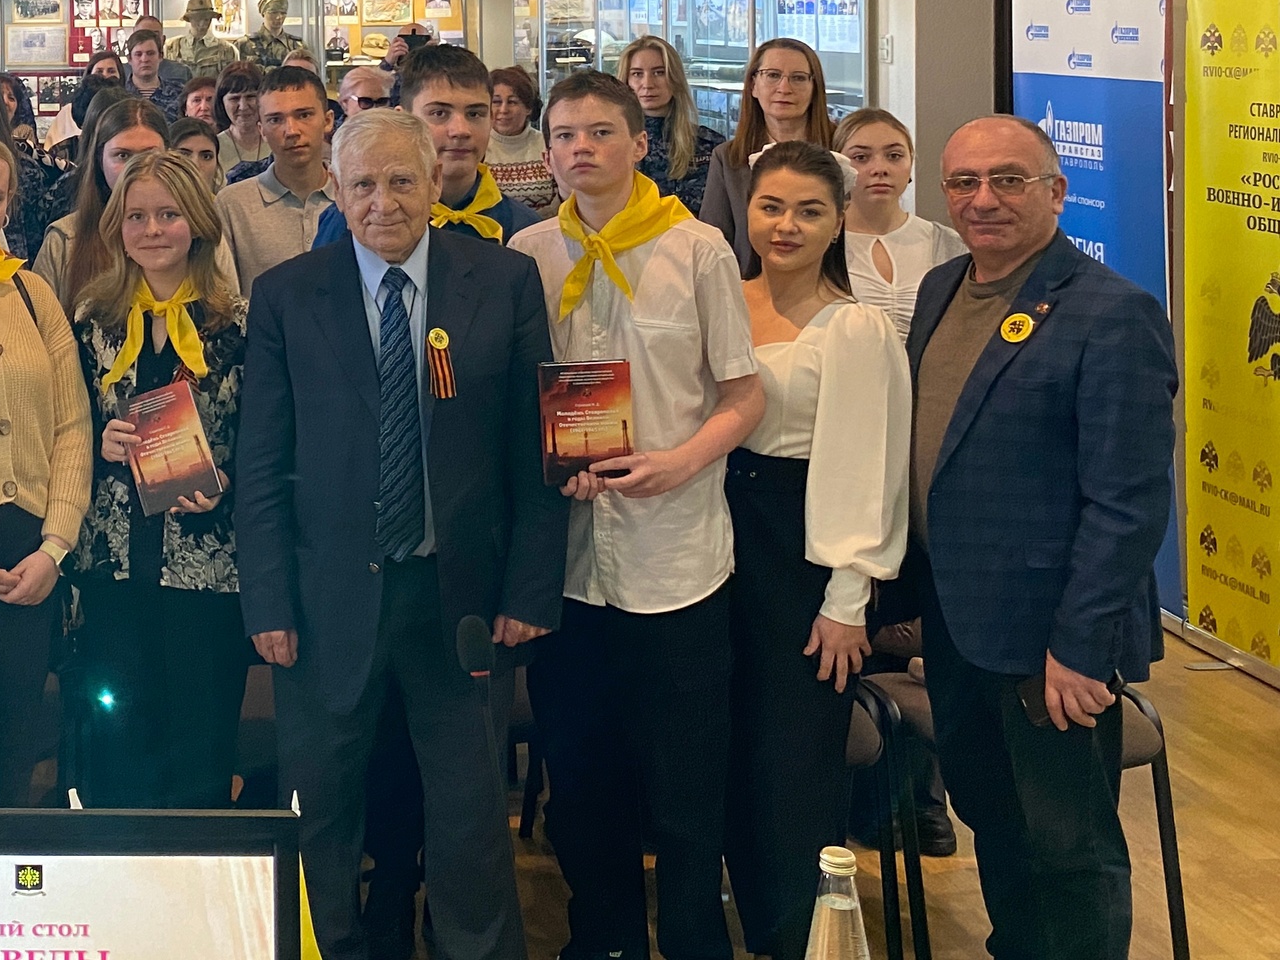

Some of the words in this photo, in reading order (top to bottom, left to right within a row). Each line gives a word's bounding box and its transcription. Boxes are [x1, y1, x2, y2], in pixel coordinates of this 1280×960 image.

[1054, 119, 1103, 146] ГАЗПРОМ
[1056, 144, 1102, 158] ТРАНСГАЗ
[1060, 156, 1104, 171] ТАВРОПОЛЬ
[1077, 196, 1106, 210] спонсор
[1202, 481, 1271, 517] RVIO-CK@MAIL.RU
[1201, 564, 1270, 604] RVIO-CK@MAIL.RU
[32, 922, 90, 938] стол
